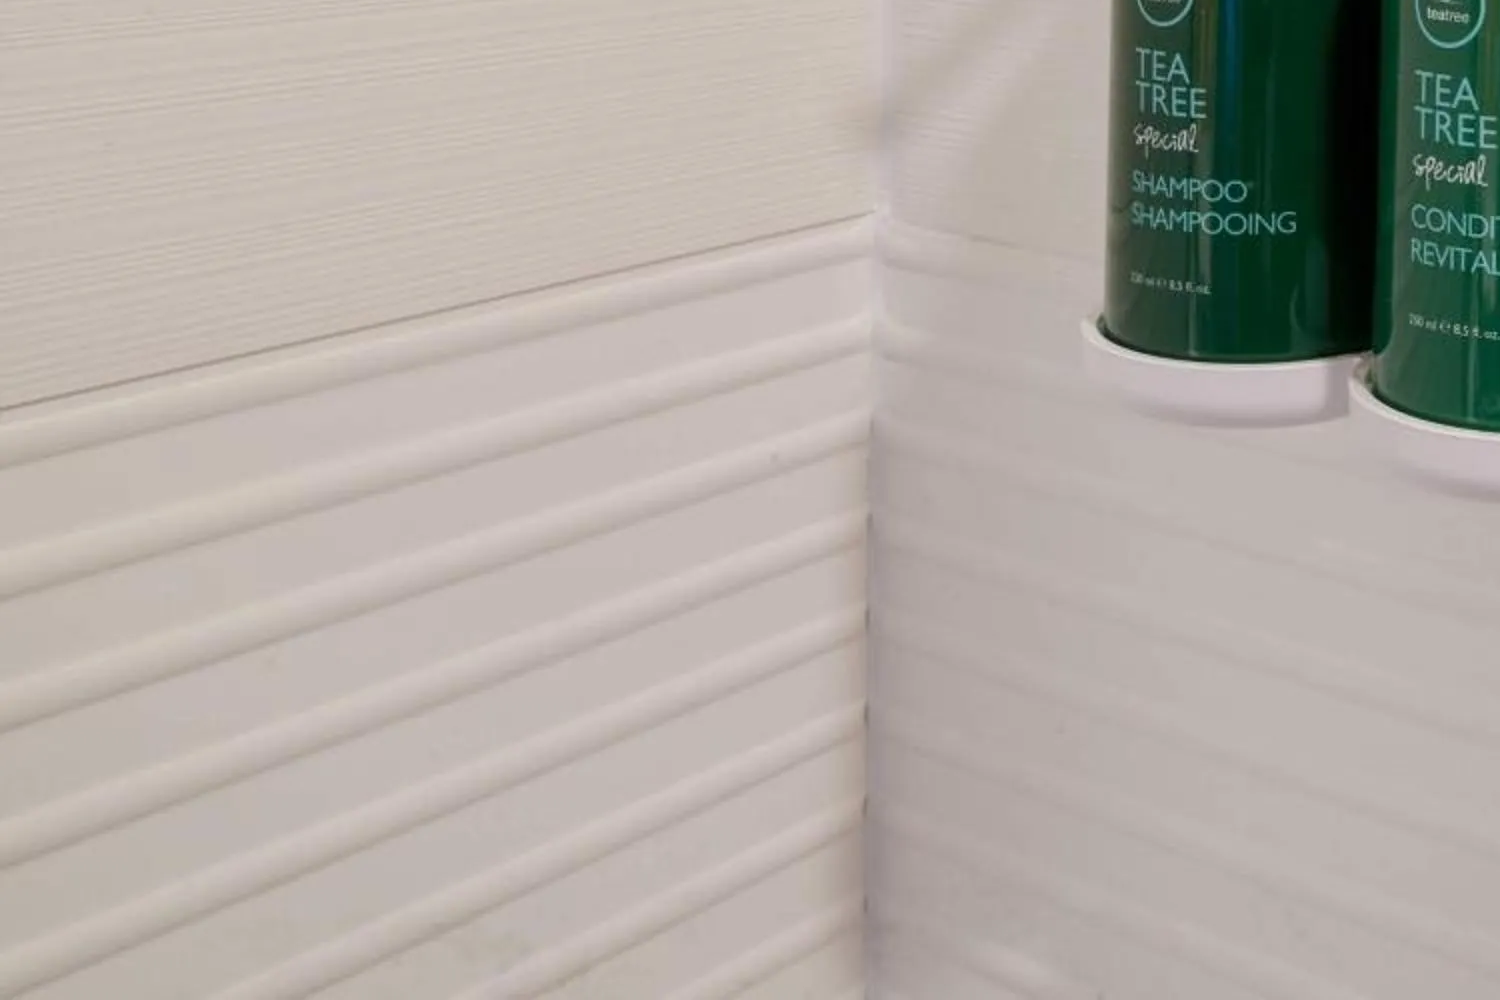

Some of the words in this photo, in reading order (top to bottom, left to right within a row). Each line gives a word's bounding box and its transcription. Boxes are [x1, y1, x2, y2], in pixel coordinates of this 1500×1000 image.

[1136, 47, 1190, 85] TEA
[1136, 80, 1207, 119] TREE
[1415, 69, 1479, 111] TEA
[1133, 123, 1200, 160] special
[1415, 105, 1499, 150] TREE
[1132, 169, 1248, 203] SHAMPOO
[1412, 153, 1489, 192] special
[1132, 202, 1298, 236] SHAMPOOING
